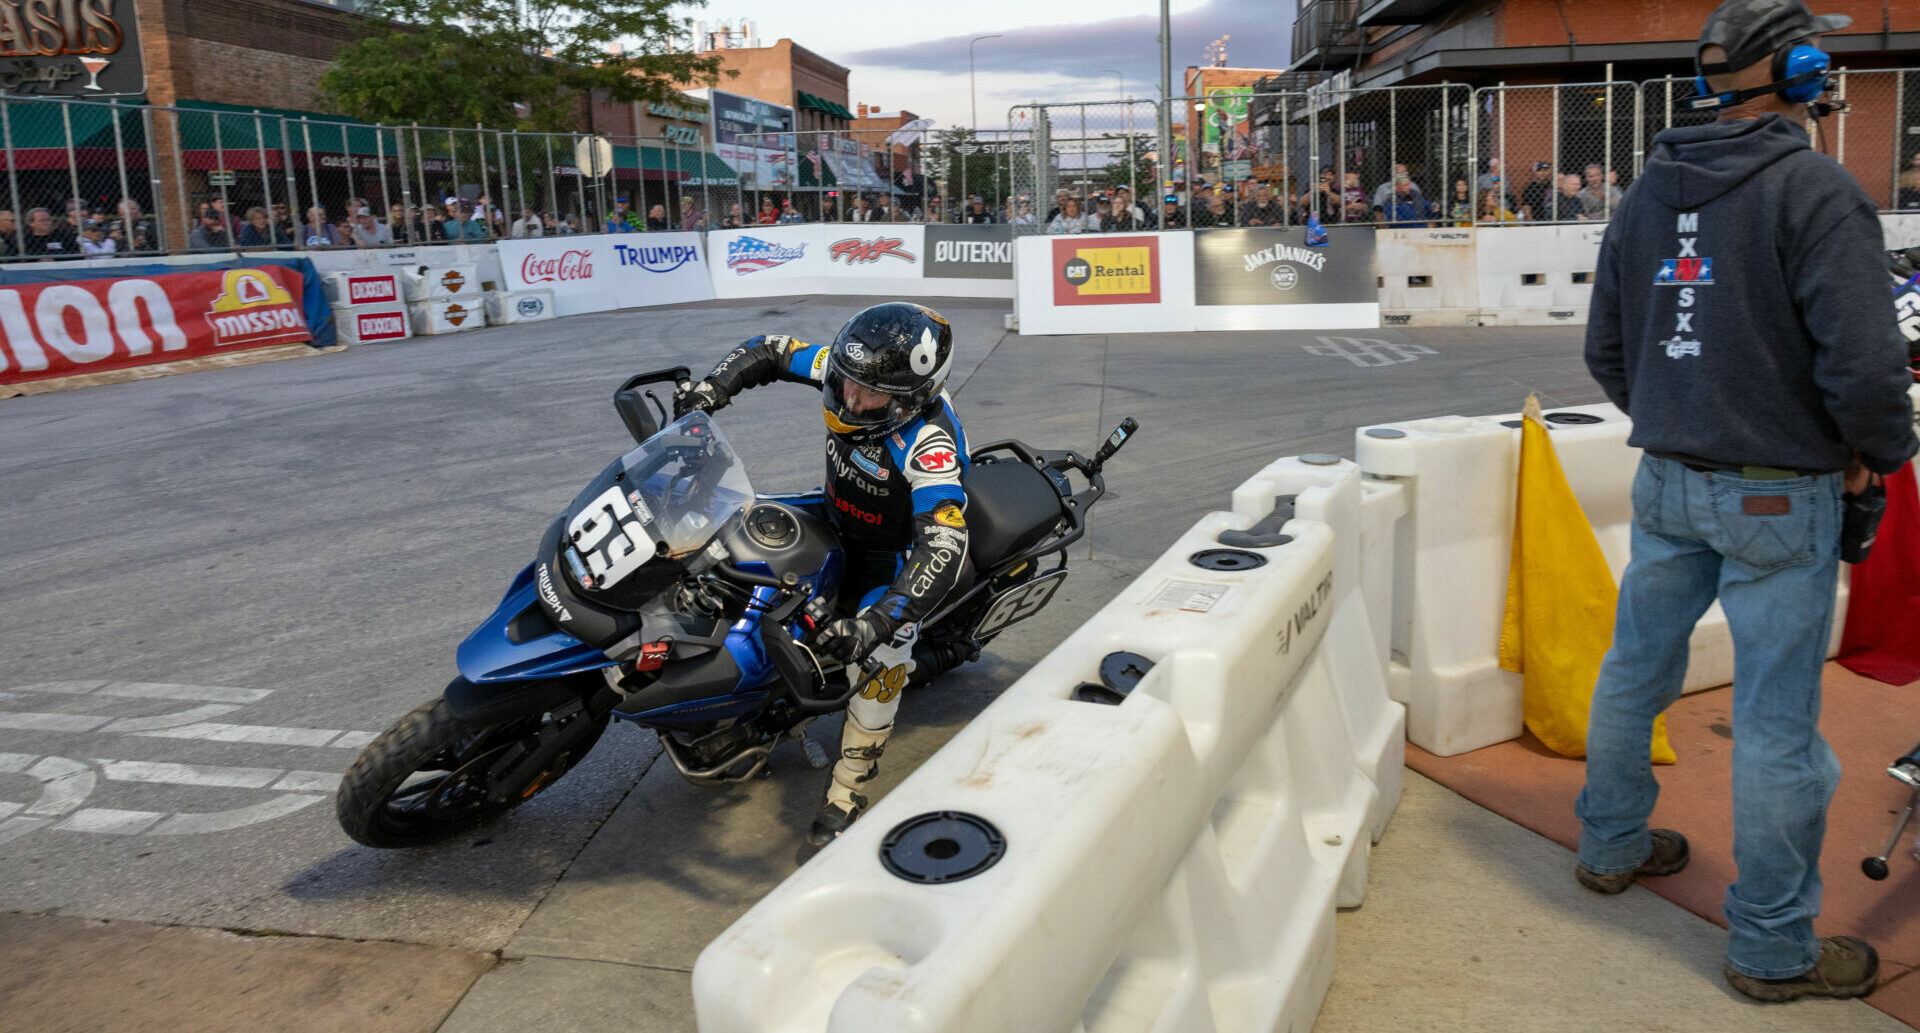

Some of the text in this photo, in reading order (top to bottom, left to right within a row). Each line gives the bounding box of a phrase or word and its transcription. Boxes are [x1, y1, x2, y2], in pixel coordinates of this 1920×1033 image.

[614, 245, 698, 273] TRIUMPH
[1066, 264, 1145, 278] CAT Rental
[1243, 248, 1275, 272] JACK
[826, 438, 891, 497] OnlyFans
[538, 562, 563, 614] TRIUMPH
[911, 549, 952, 598] cardo
[979, 577, 1060, 634] 69
